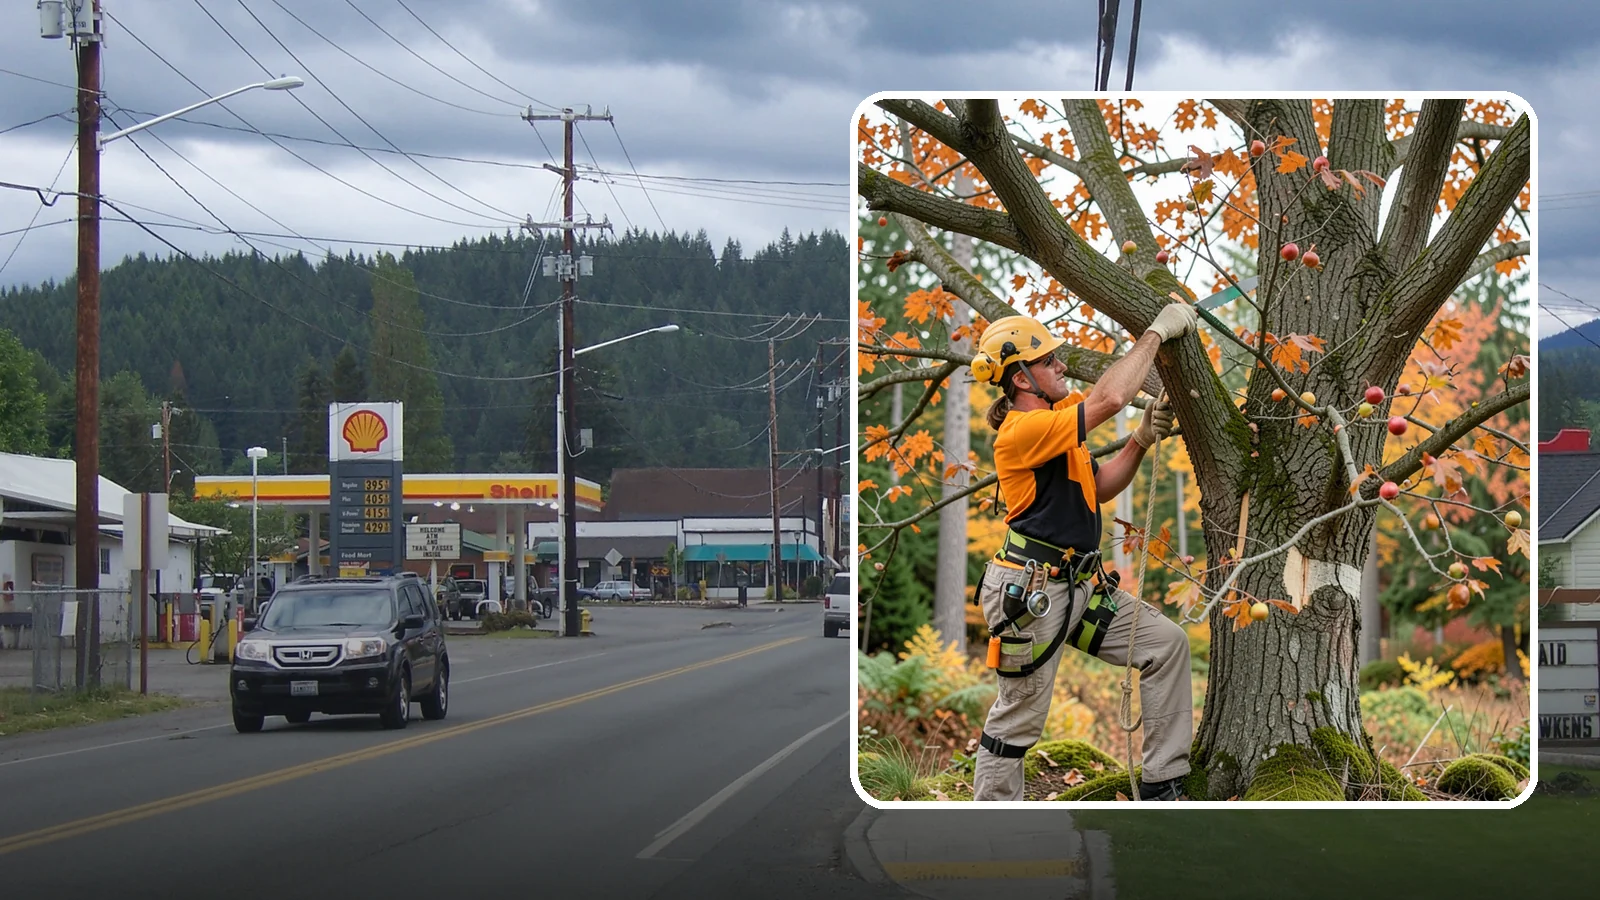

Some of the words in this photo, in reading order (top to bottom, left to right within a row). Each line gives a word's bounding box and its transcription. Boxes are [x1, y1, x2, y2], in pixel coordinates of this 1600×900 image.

[366, 480, 384, 490] 395
[490, 484, 547, 499] Shell
[366, 494, 384, 504] 405
[366, 508, 384, 518] 415
[366, 522, 384, 532] 429
